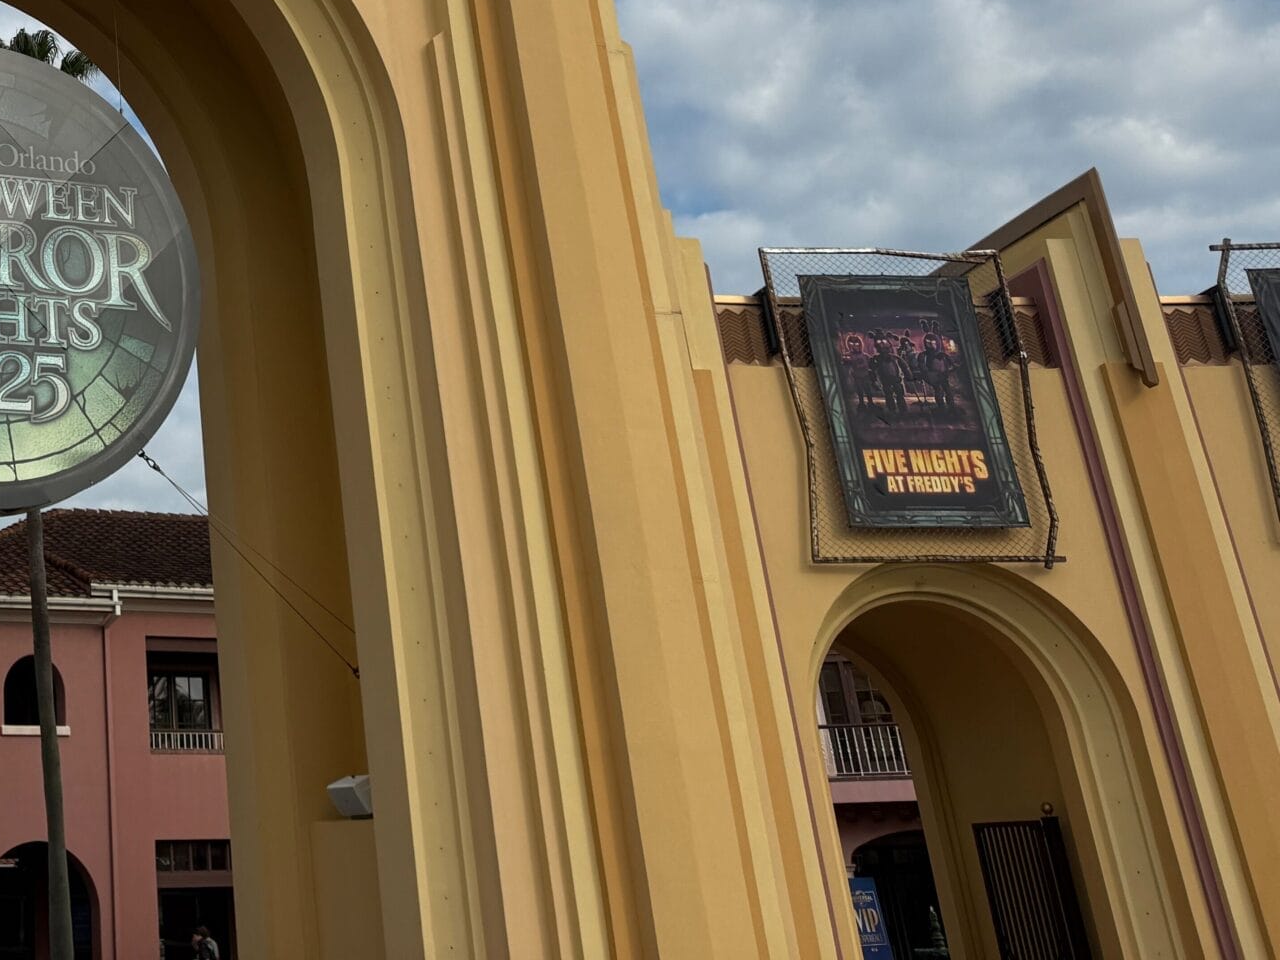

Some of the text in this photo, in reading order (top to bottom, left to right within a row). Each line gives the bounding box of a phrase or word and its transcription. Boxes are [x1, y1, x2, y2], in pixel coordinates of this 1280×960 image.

[862, 449, 989, 479] FIVE NIGHTS
[886, 475, 976, 493] AT FREDDY'S
